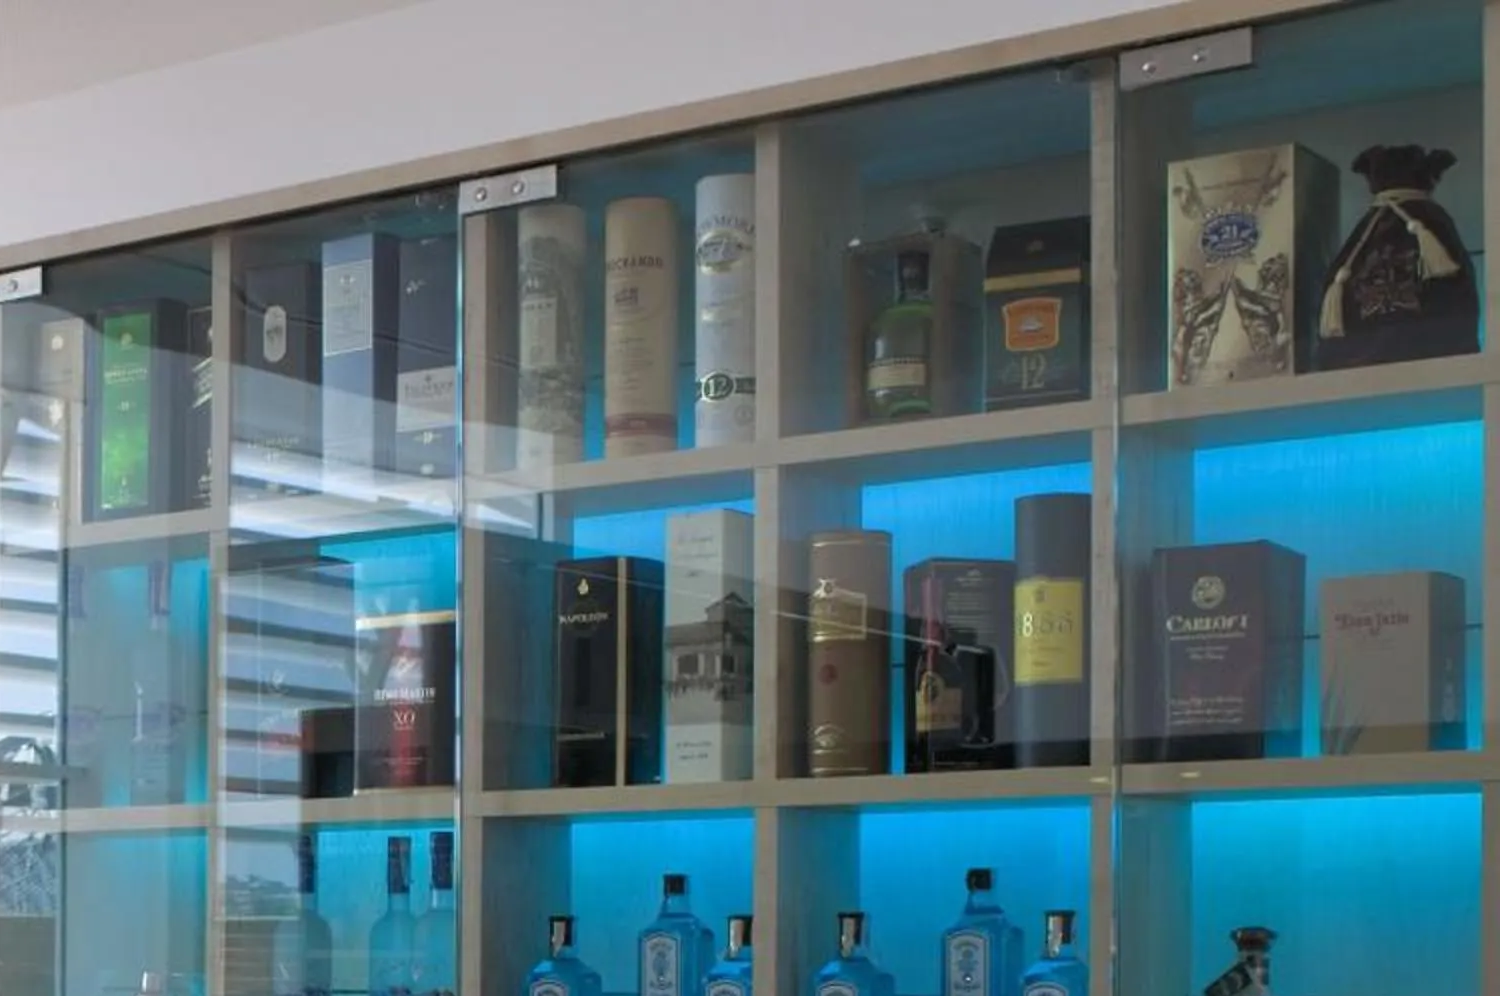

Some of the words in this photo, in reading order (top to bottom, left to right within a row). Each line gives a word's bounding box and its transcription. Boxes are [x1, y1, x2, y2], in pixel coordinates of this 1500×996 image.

[1219, 224, 1238, 241] 21
[1021, 353, 1047, 391] 12
[708, 378, 729, 398] 12
[394, 710, 416, 726] XO
